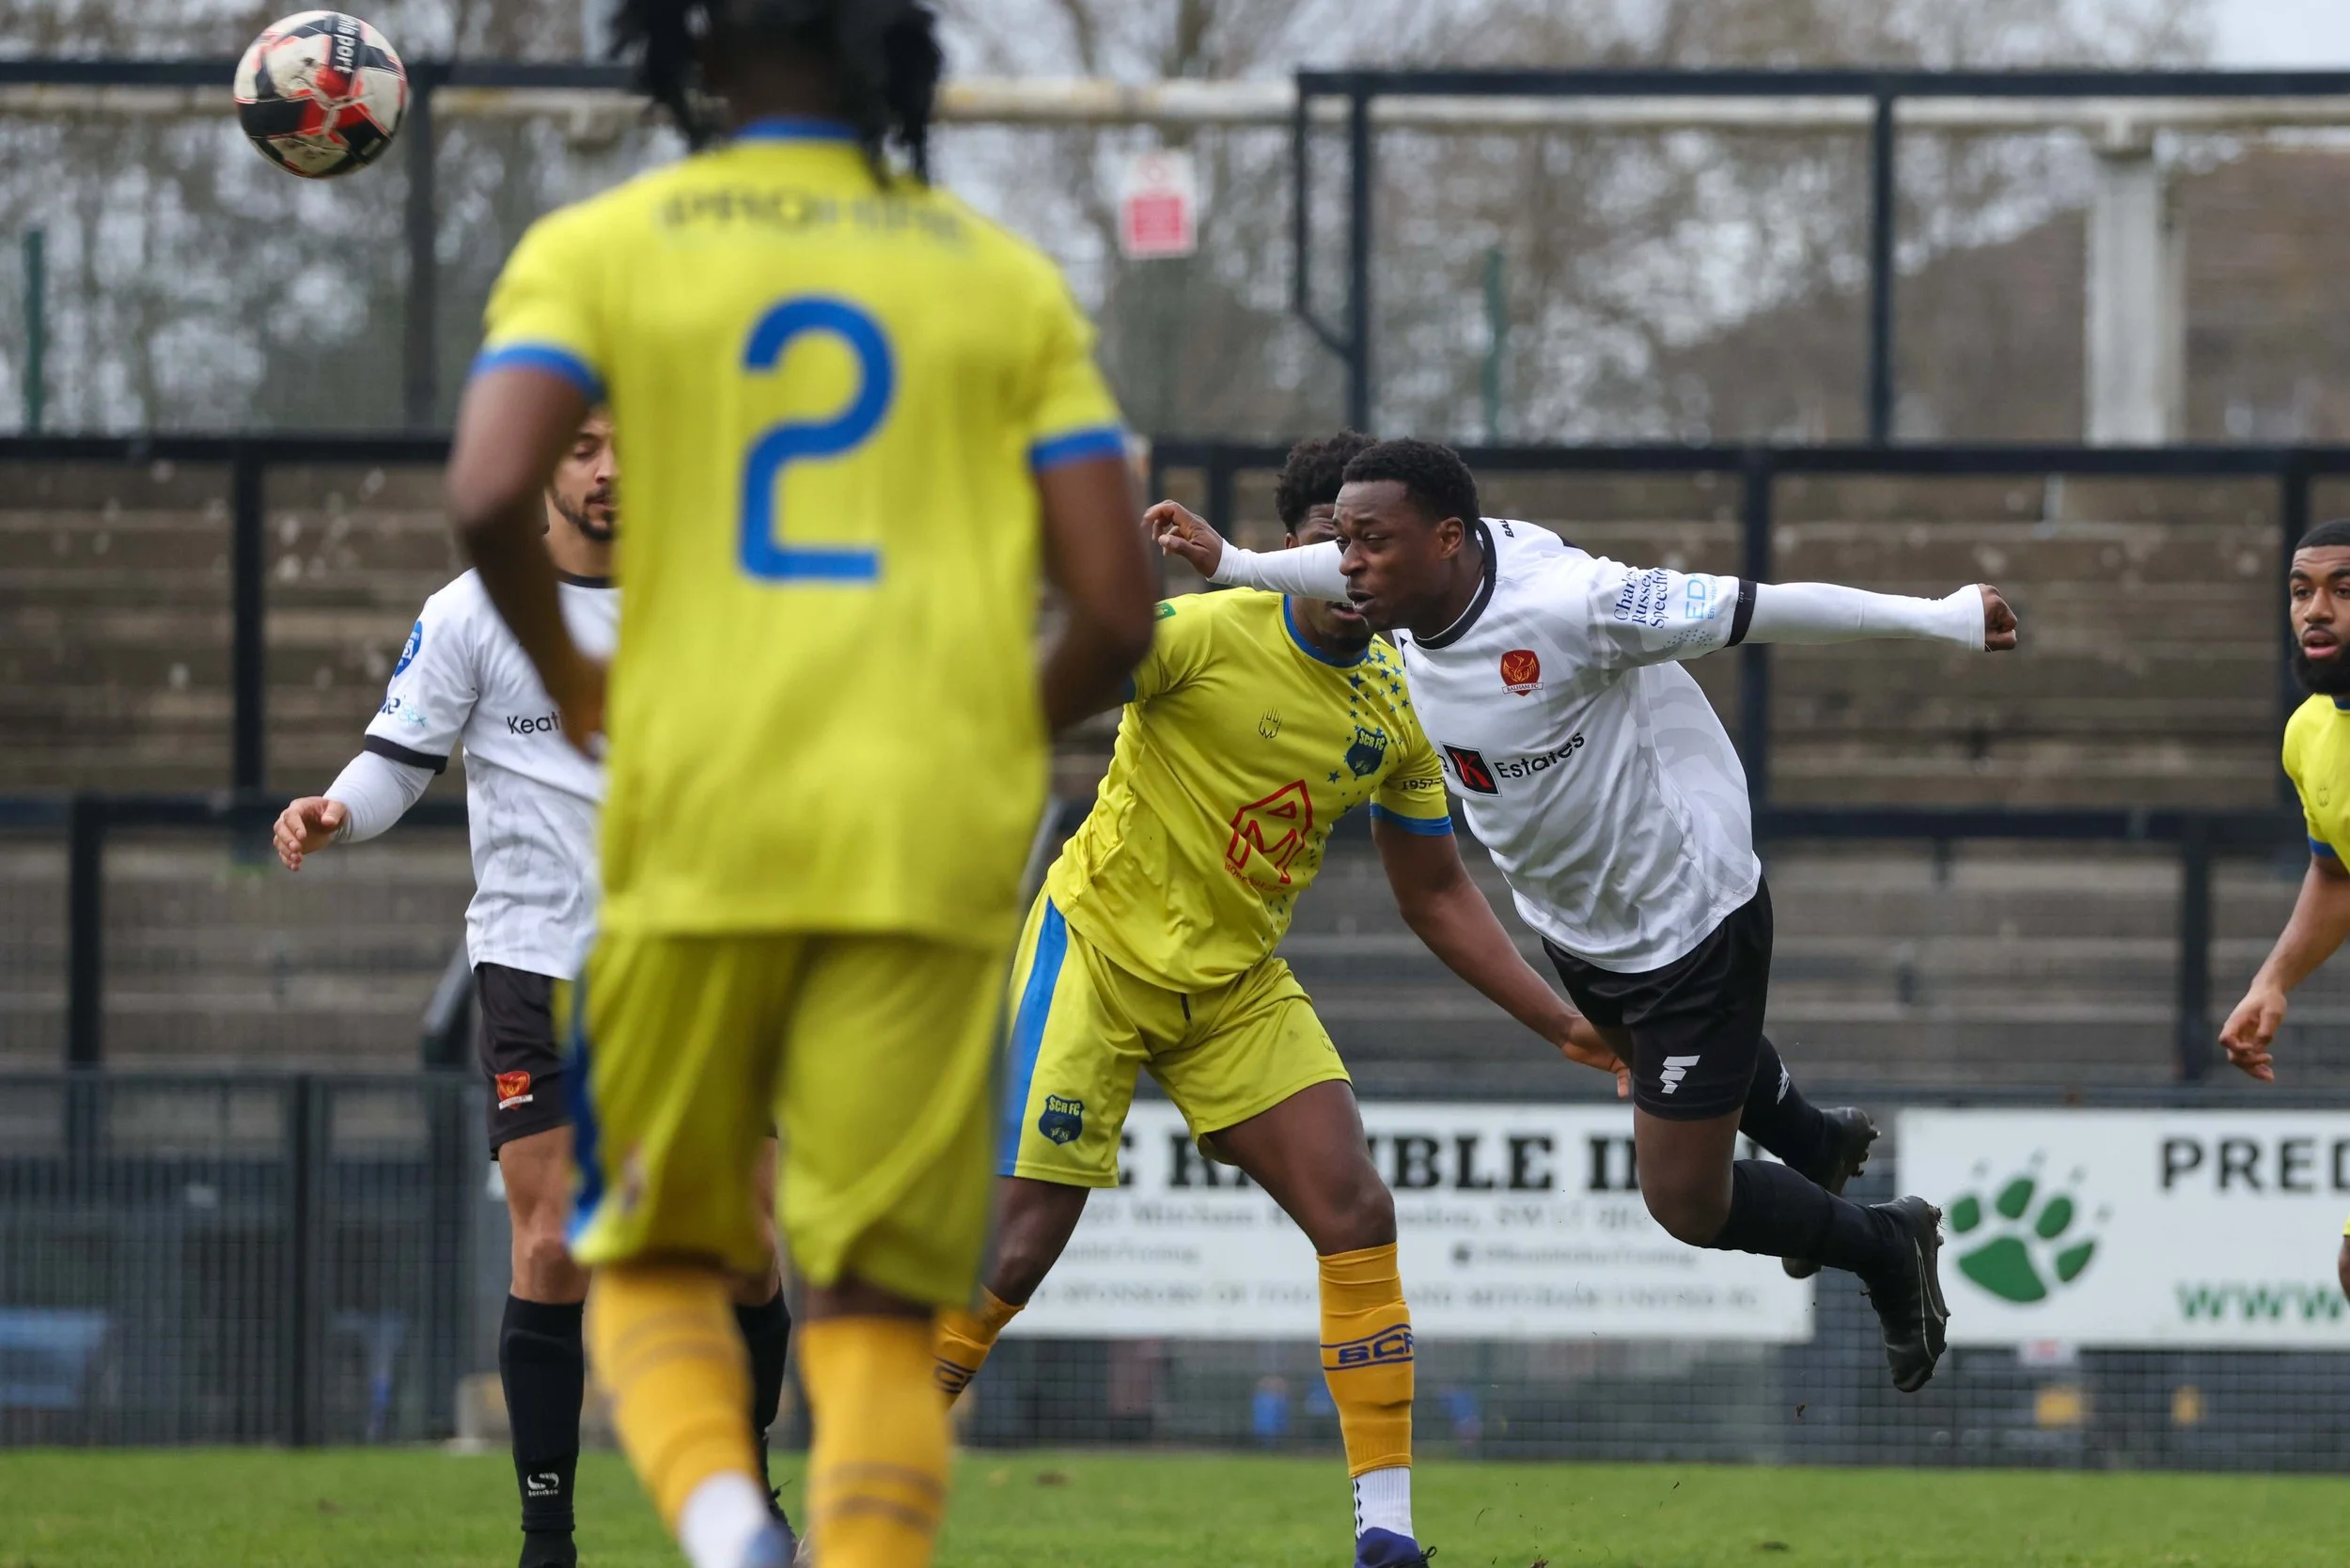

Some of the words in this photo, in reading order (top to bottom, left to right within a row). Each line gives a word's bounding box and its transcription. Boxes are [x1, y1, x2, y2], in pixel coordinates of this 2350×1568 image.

[737, 293, 901, 582] 2
[1499, 519, 1514, 538] BAL
[506, 711, 563, 734] Keat
[1493, 732, 1586, 778] Estates
